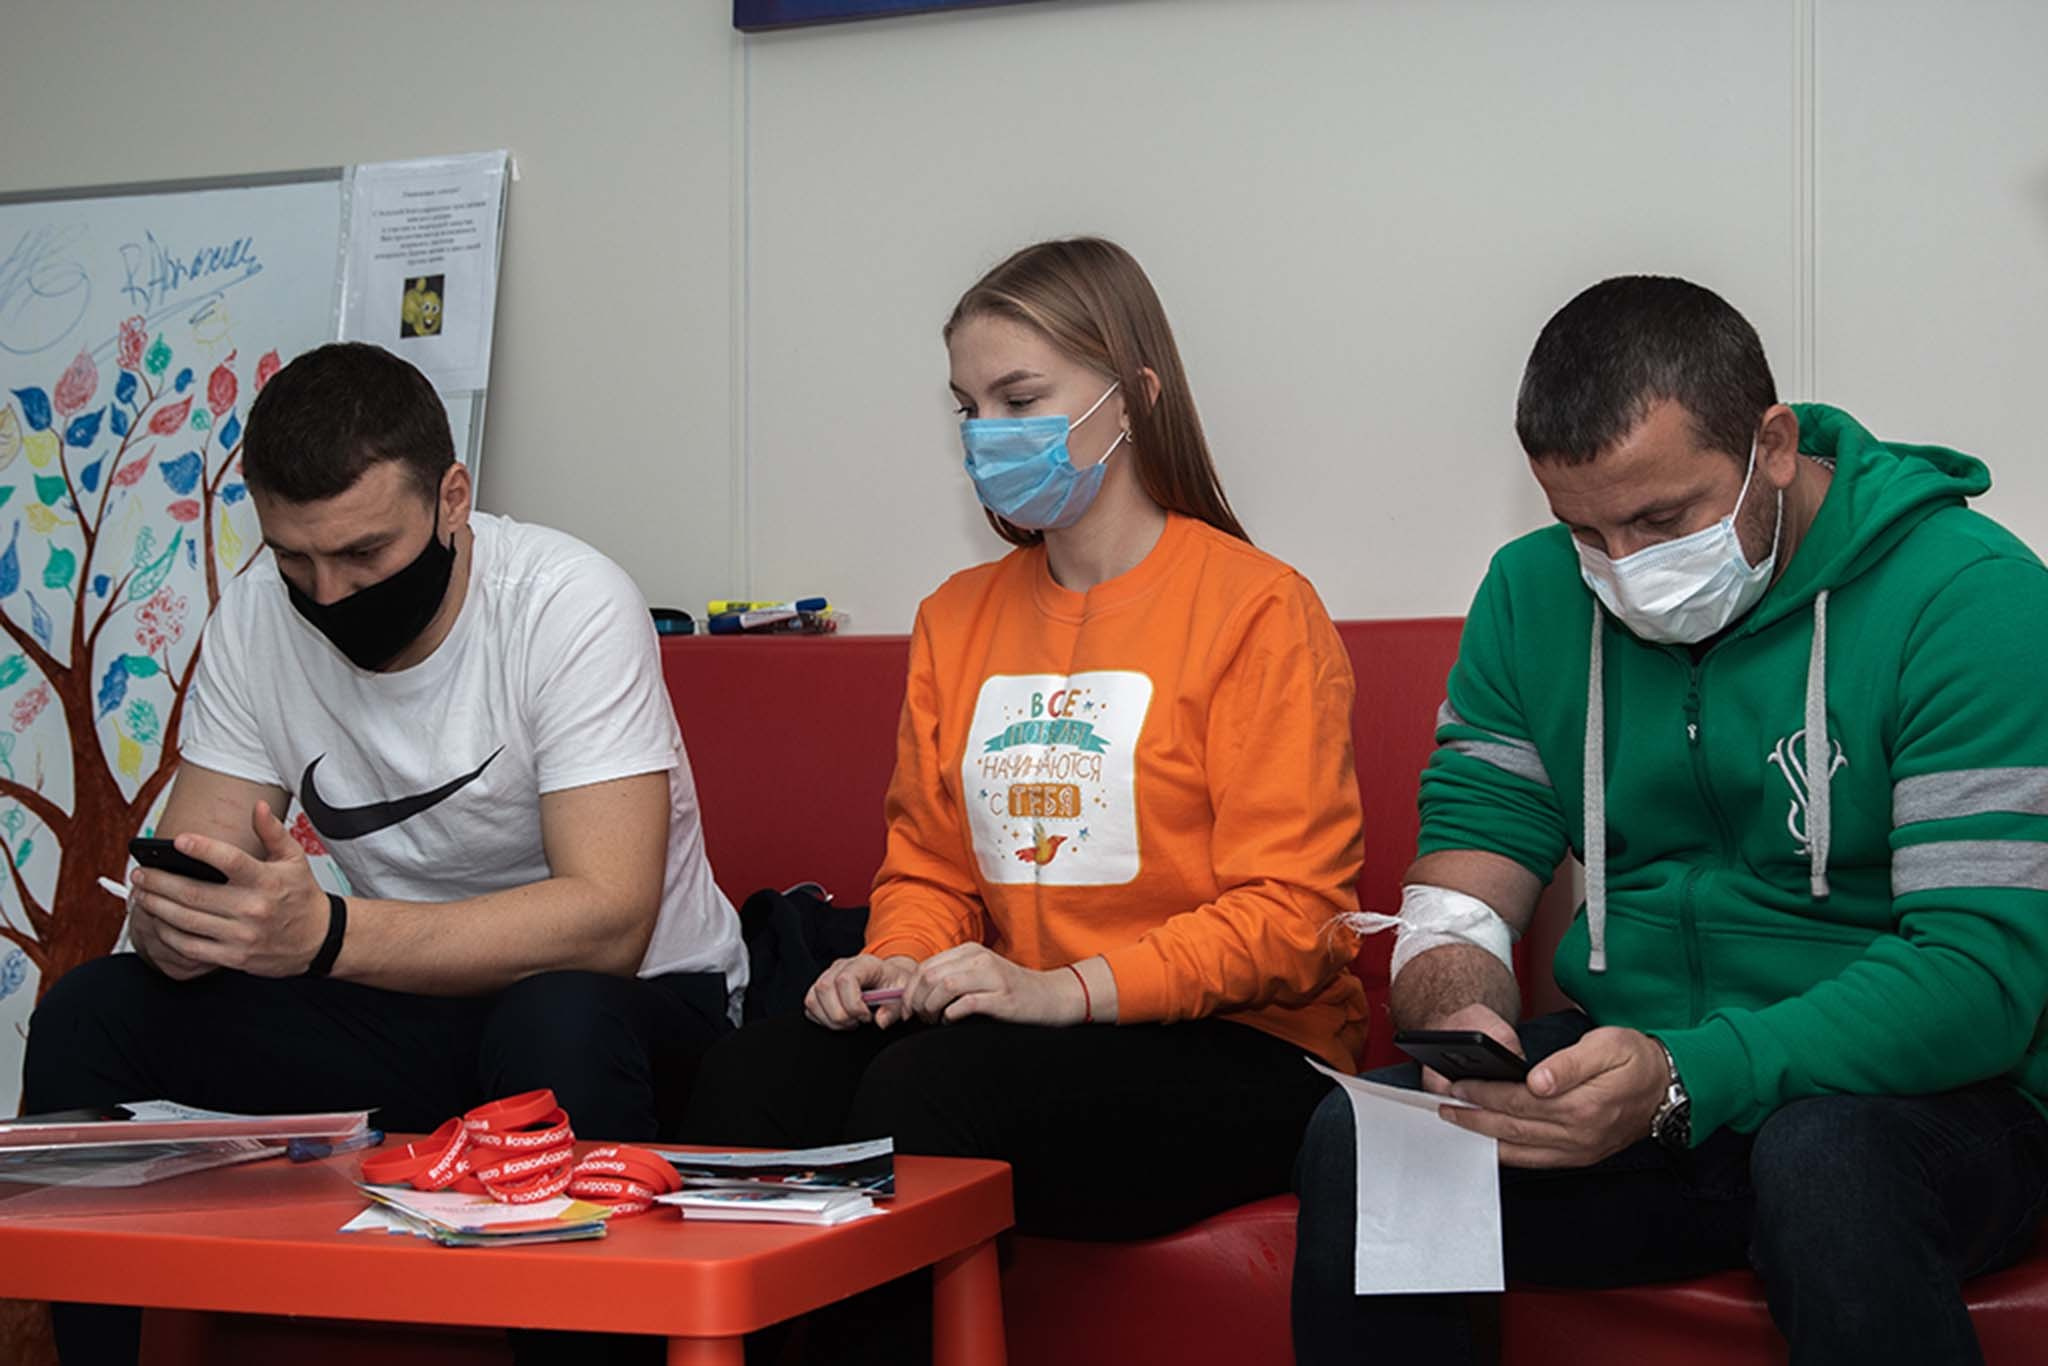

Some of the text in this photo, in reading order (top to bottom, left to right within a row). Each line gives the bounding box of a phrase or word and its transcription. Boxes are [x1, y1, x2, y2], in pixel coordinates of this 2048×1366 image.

[1031, 689, 1082, 718] ВСЕ
[982, 751, 1103, 783] НАЧИНАЮТСЯ
[1011, 786, 1074, 817] ТЕБЯ
